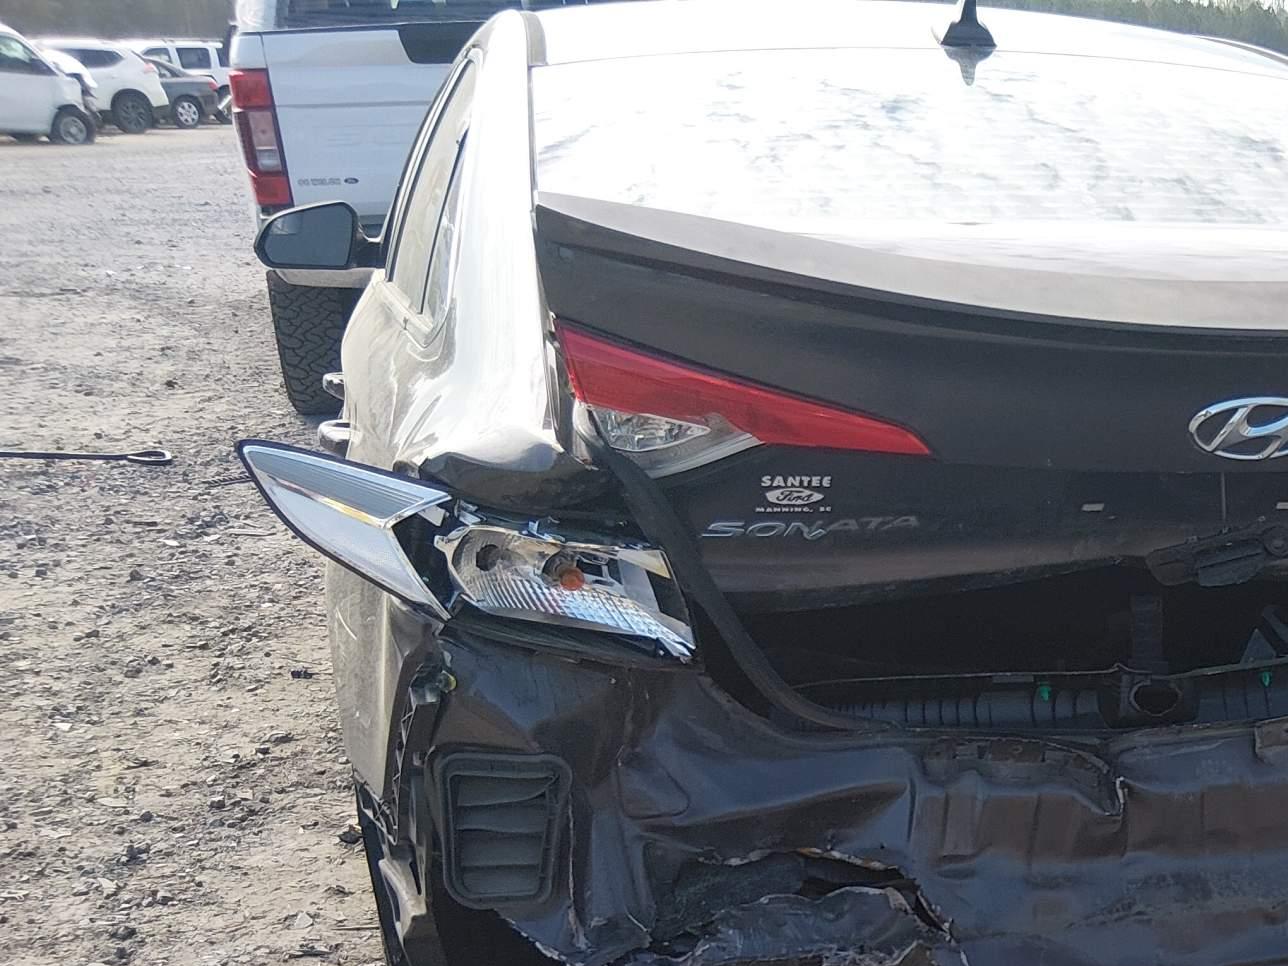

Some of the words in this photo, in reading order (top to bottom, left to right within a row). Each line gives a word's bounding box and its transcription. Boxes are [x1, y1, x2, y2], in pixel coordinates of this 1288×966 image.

[760, 475, 832, 487] SANTEE
[776, 489, 814, 502] Ford
[701, 515, 919, 540] SONATA
